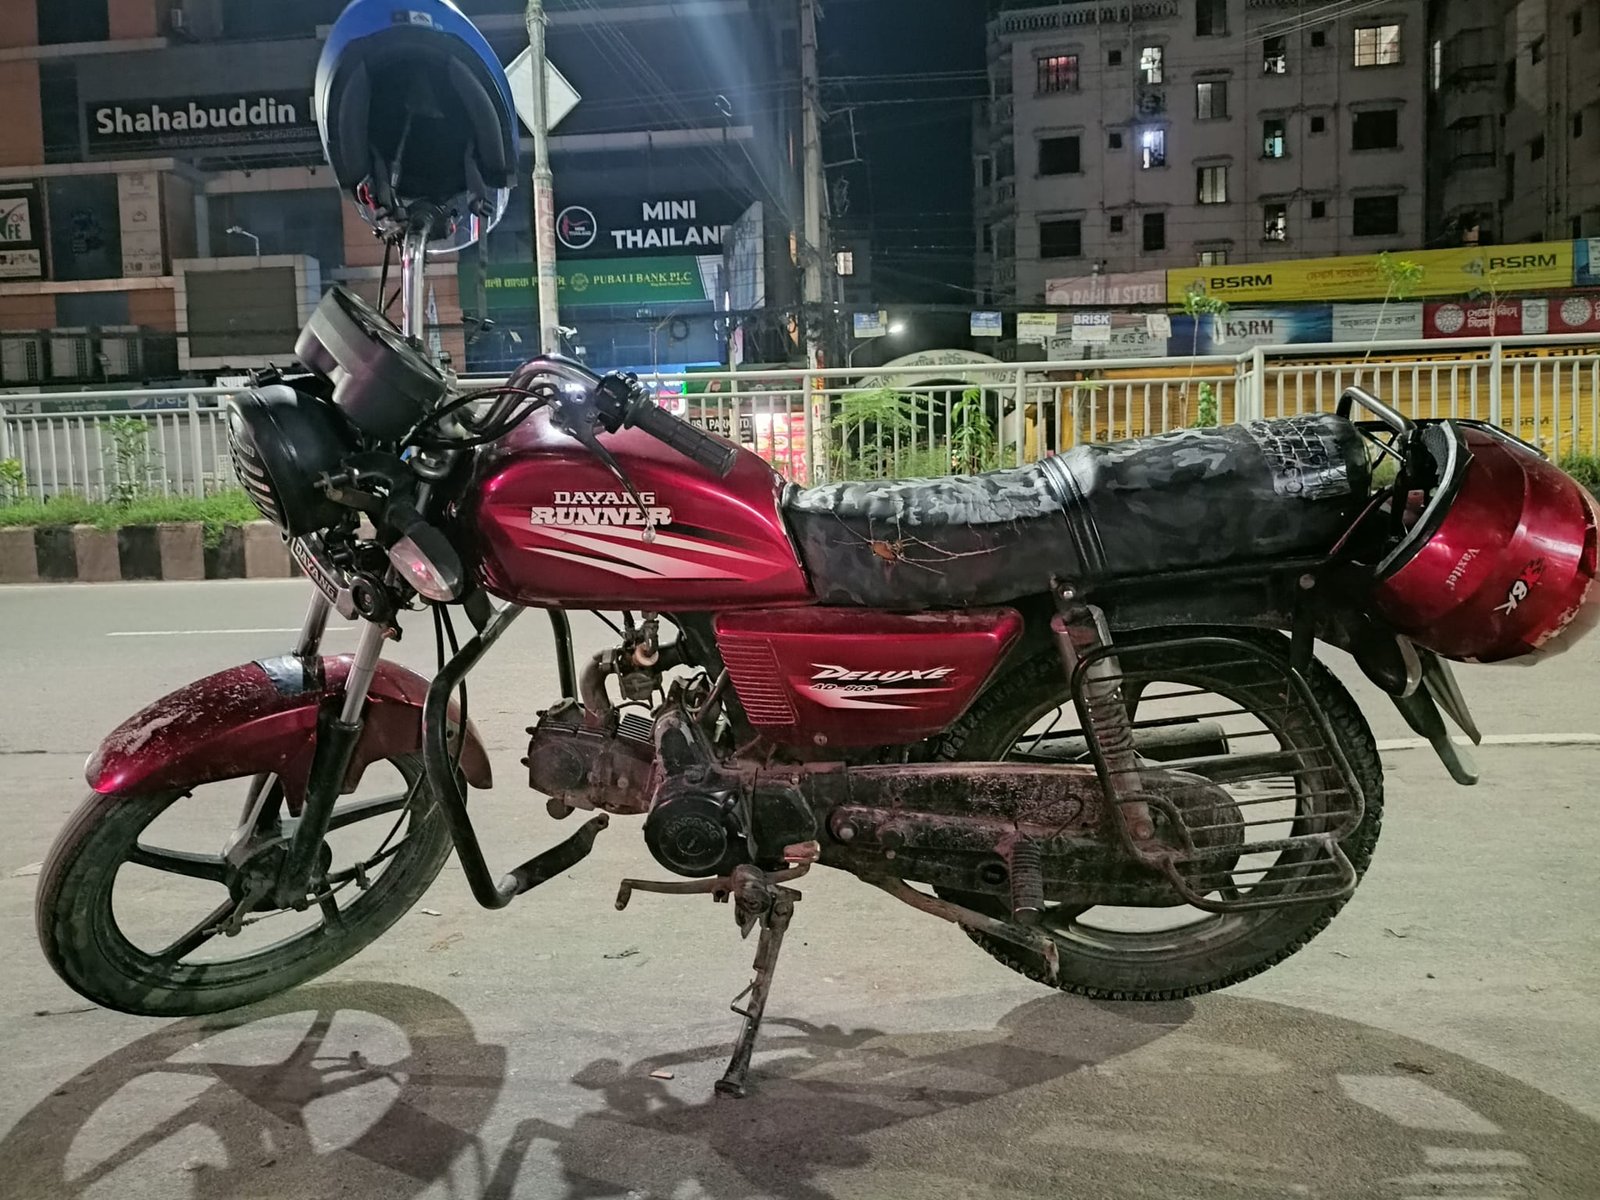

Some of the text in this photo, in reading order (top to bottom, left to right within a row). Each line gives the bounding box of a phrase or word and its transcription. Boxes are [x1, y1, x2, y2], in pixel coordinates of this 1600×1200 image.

[96, 98, 296, 133] Shahabuddin
[643, 200, 697, 222] MINI
[1490, 254, 1557, 269] BSRM
[593, 271, 693, 284] PUBALI BANK PLC
[1210, 274, 1273, 289] BSRM
[1123, 283, 1163, 302] STEEL
[1073, 314, 1110, 325] BRISK
[554, 491, 656, 505] DAYANG
[531, 506, 673, 526] RUNNER
[295, 542, 337, 598] DAYANG
